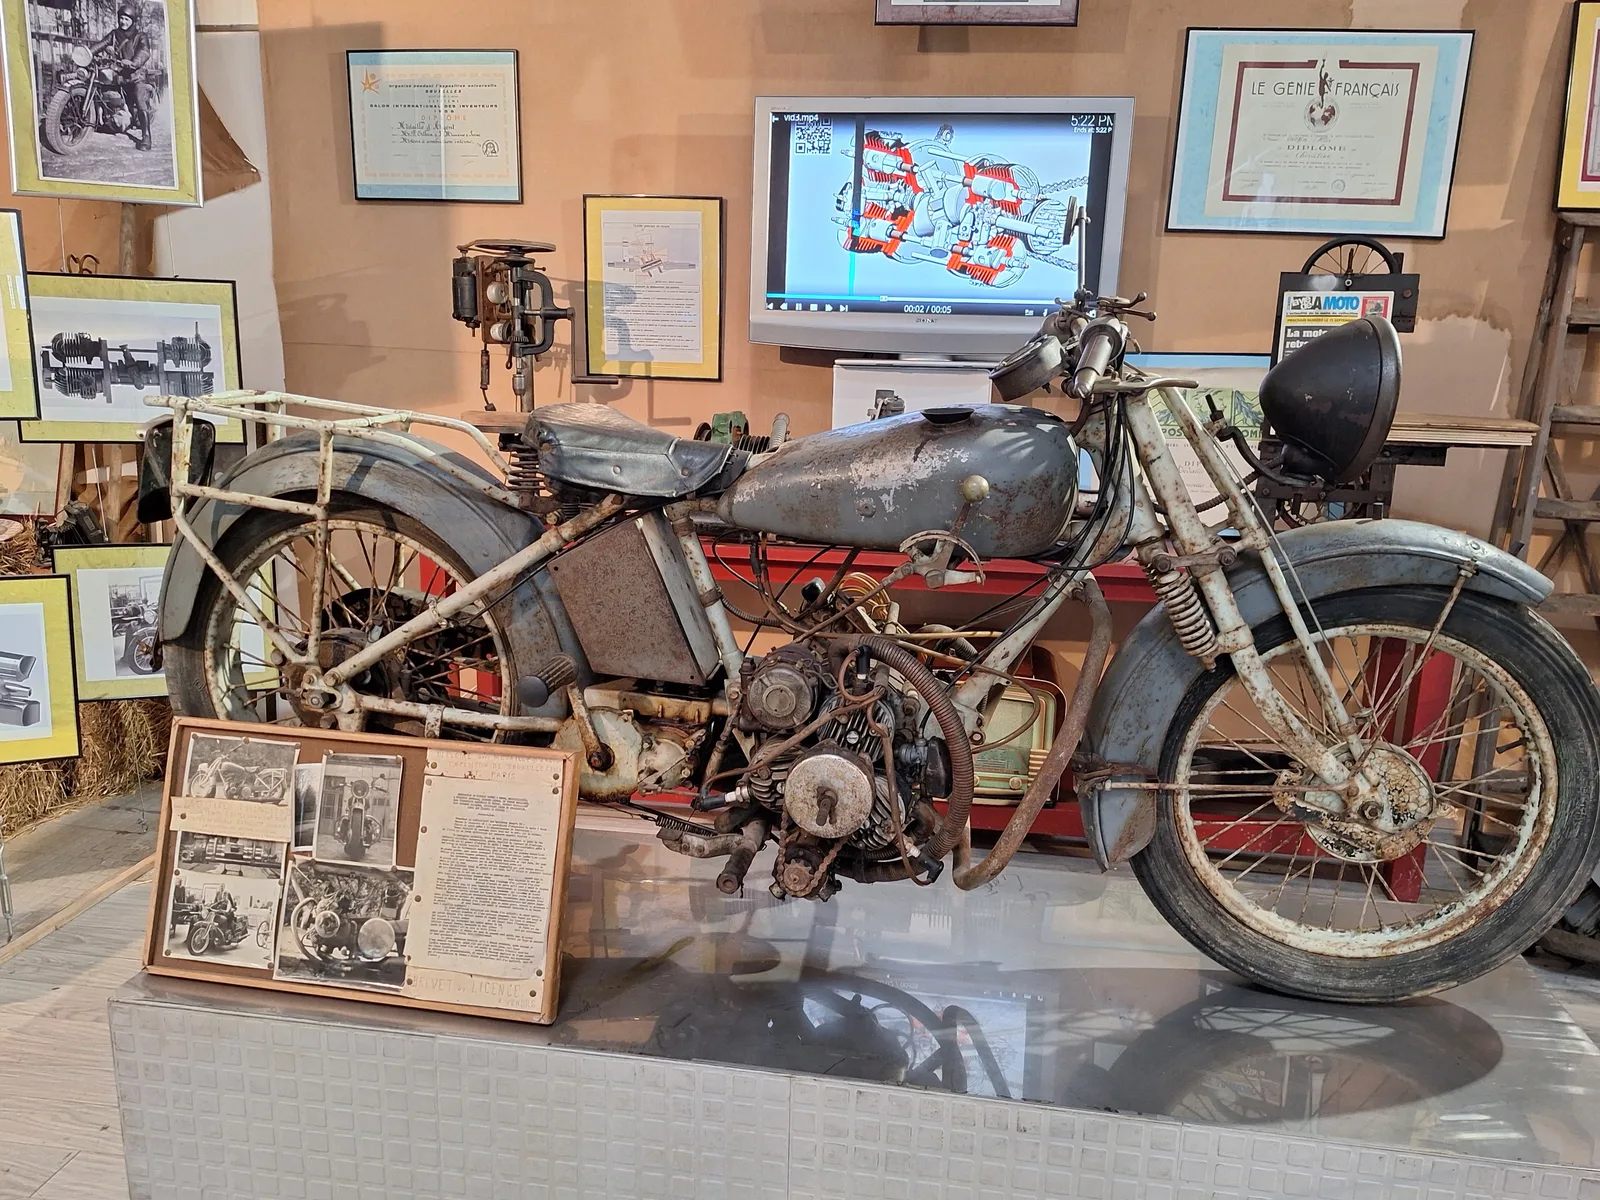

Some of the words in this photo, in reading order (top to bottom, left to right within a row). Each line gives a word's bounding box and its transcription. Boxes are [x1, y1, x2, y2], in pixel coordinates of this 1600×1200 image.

[1251, 81, 1265, 96] LE
[1335, 81, 1401, 99] FRANÇAIS
[784, 114, 819, 122] vid3.mp4
[1071, 115, 1095, 127] 5:22
[1286, 143, 1347, 152] DIPLÔME
[1323, 296, 1360, 311] MOTO
[903, 304, 925, 314] 00:02
[931, 305, 952, 314] 00:05
[1286, 328, 1300, 338] La
[491, 772, 516, 780] PARIS
[413, 975, 452, 992] BREVET
